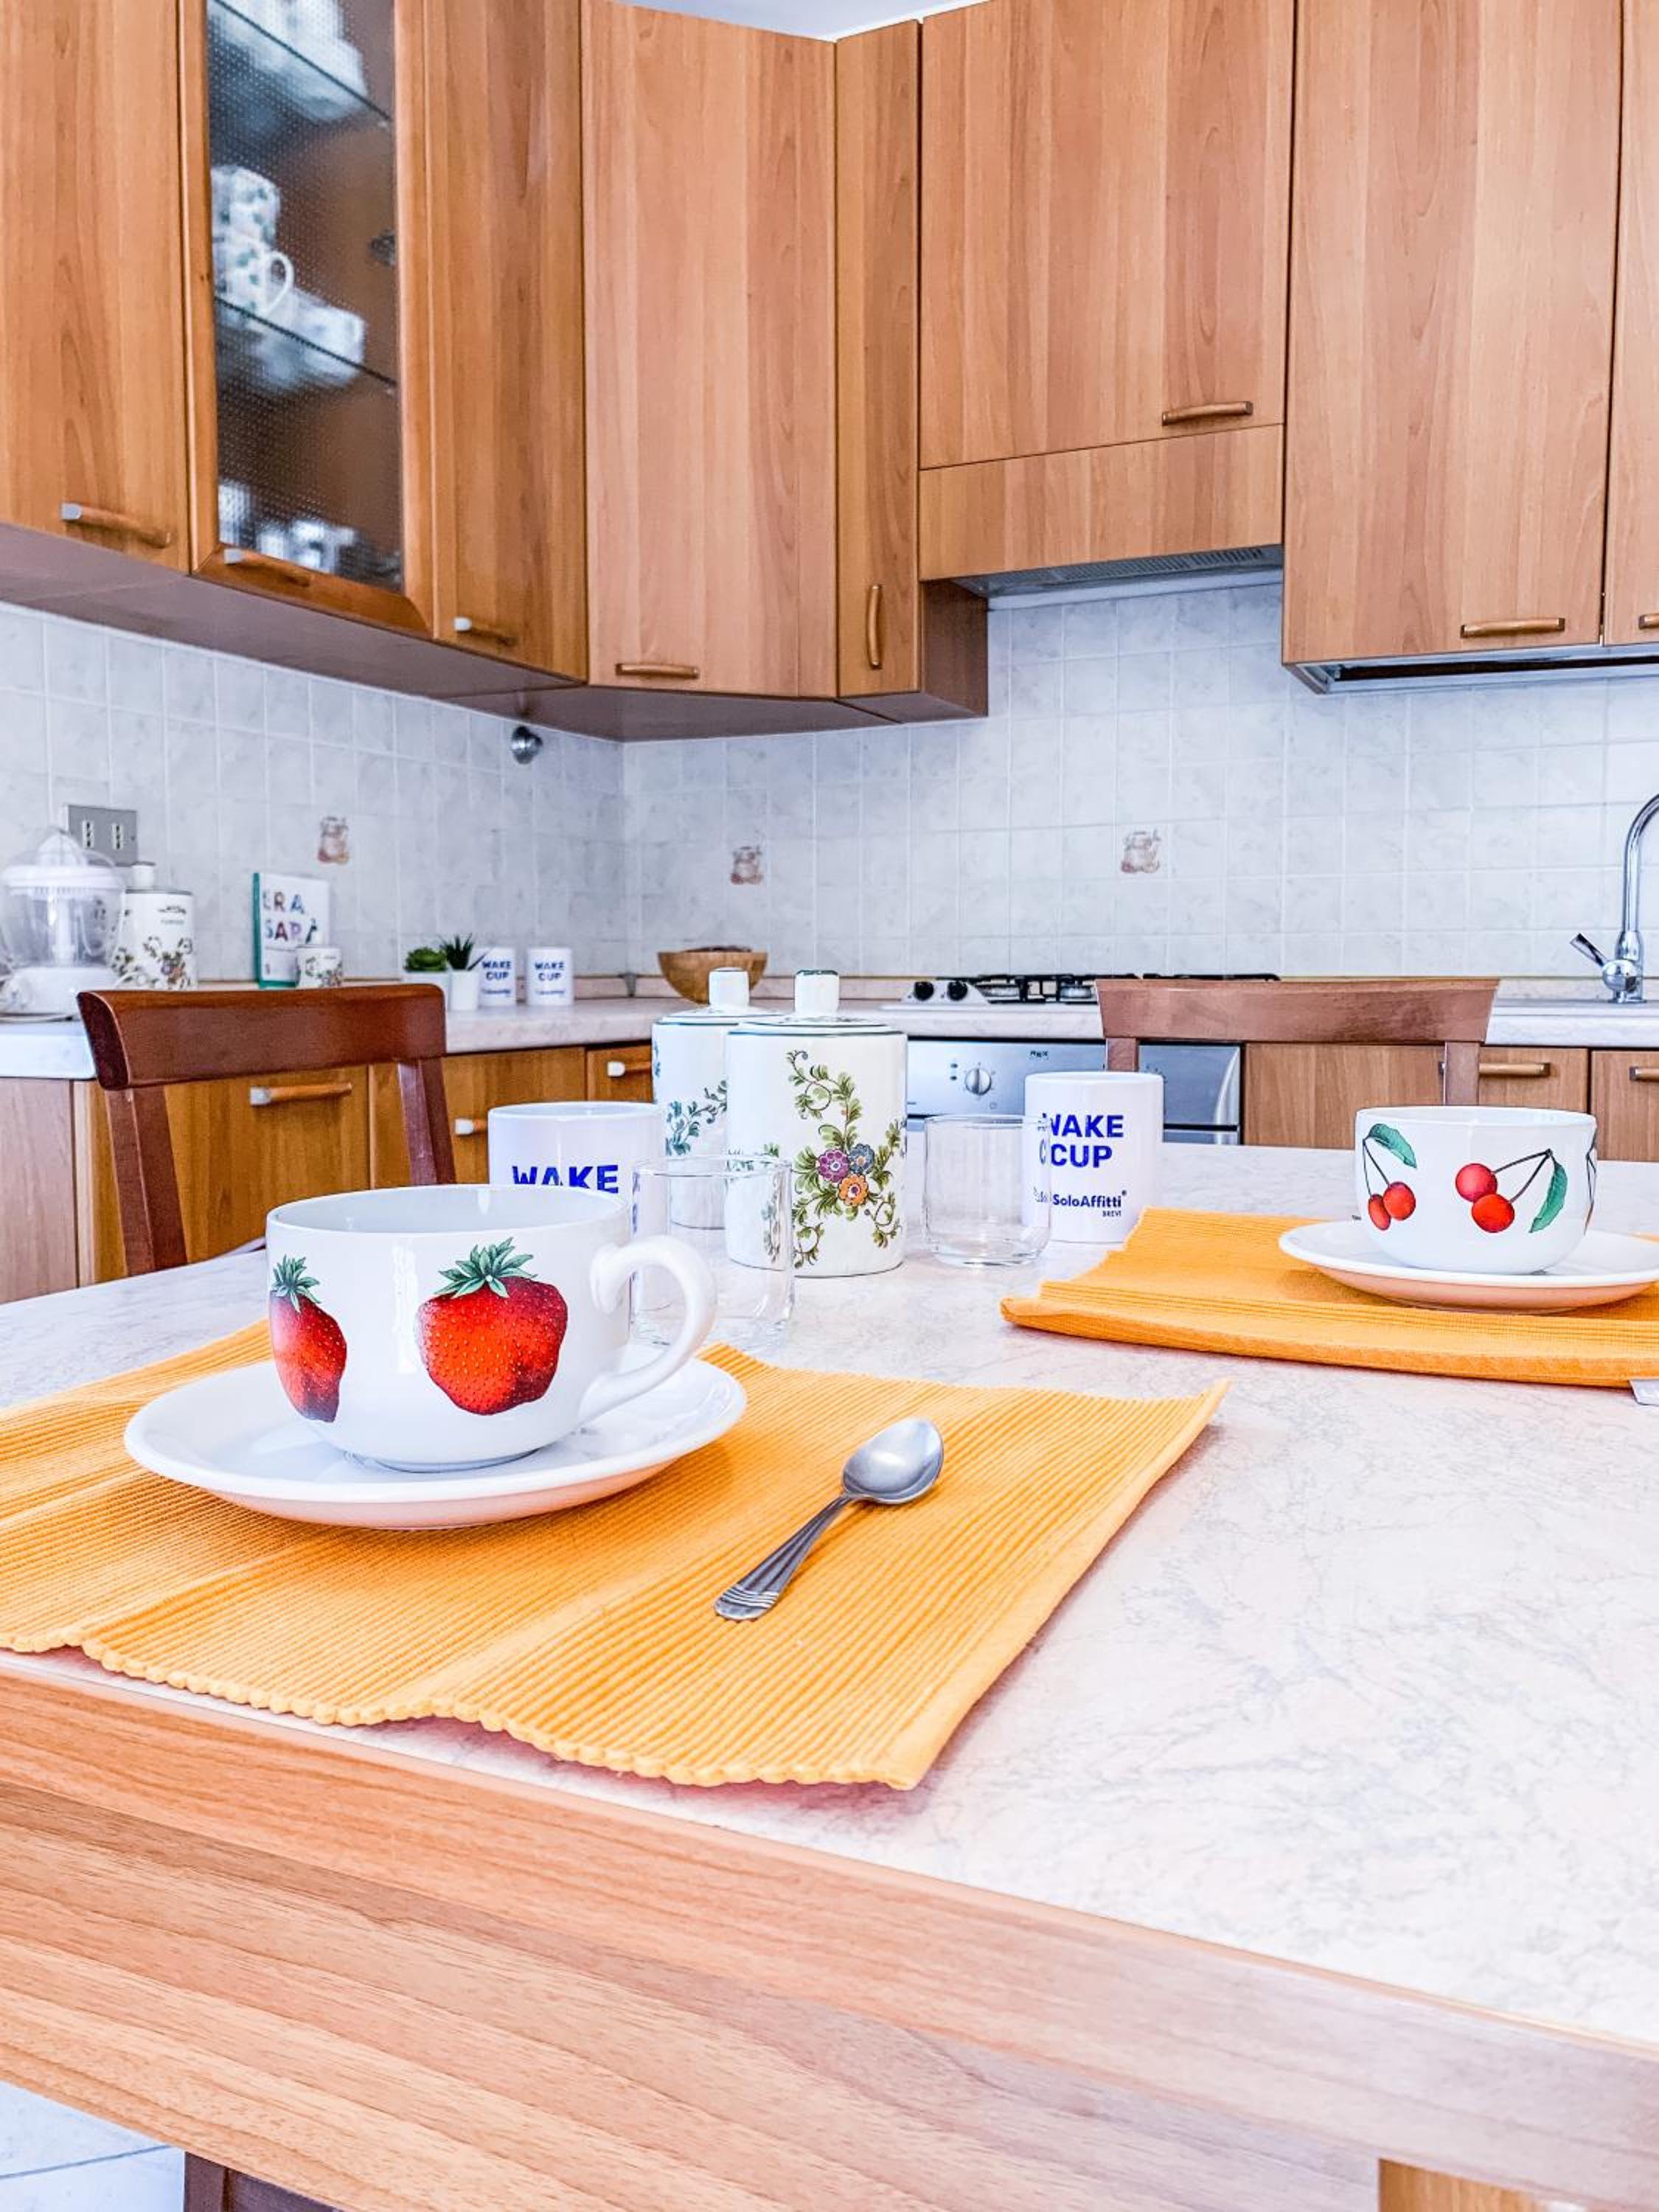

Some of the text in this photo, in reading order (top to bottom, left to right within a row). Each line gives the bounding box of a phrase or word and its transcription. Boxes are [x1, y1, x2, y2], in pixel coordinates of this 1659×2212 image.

[482, 961, 512, 970] WAKE
[535, 961, 565, 970] WAKE
[485, 971, 509, 981] CUP
[538, 972, 561, 981] CUP
[1051, 1144, 1113, 1168] CUP
[512, 1164, 619, 1194] WAKE
